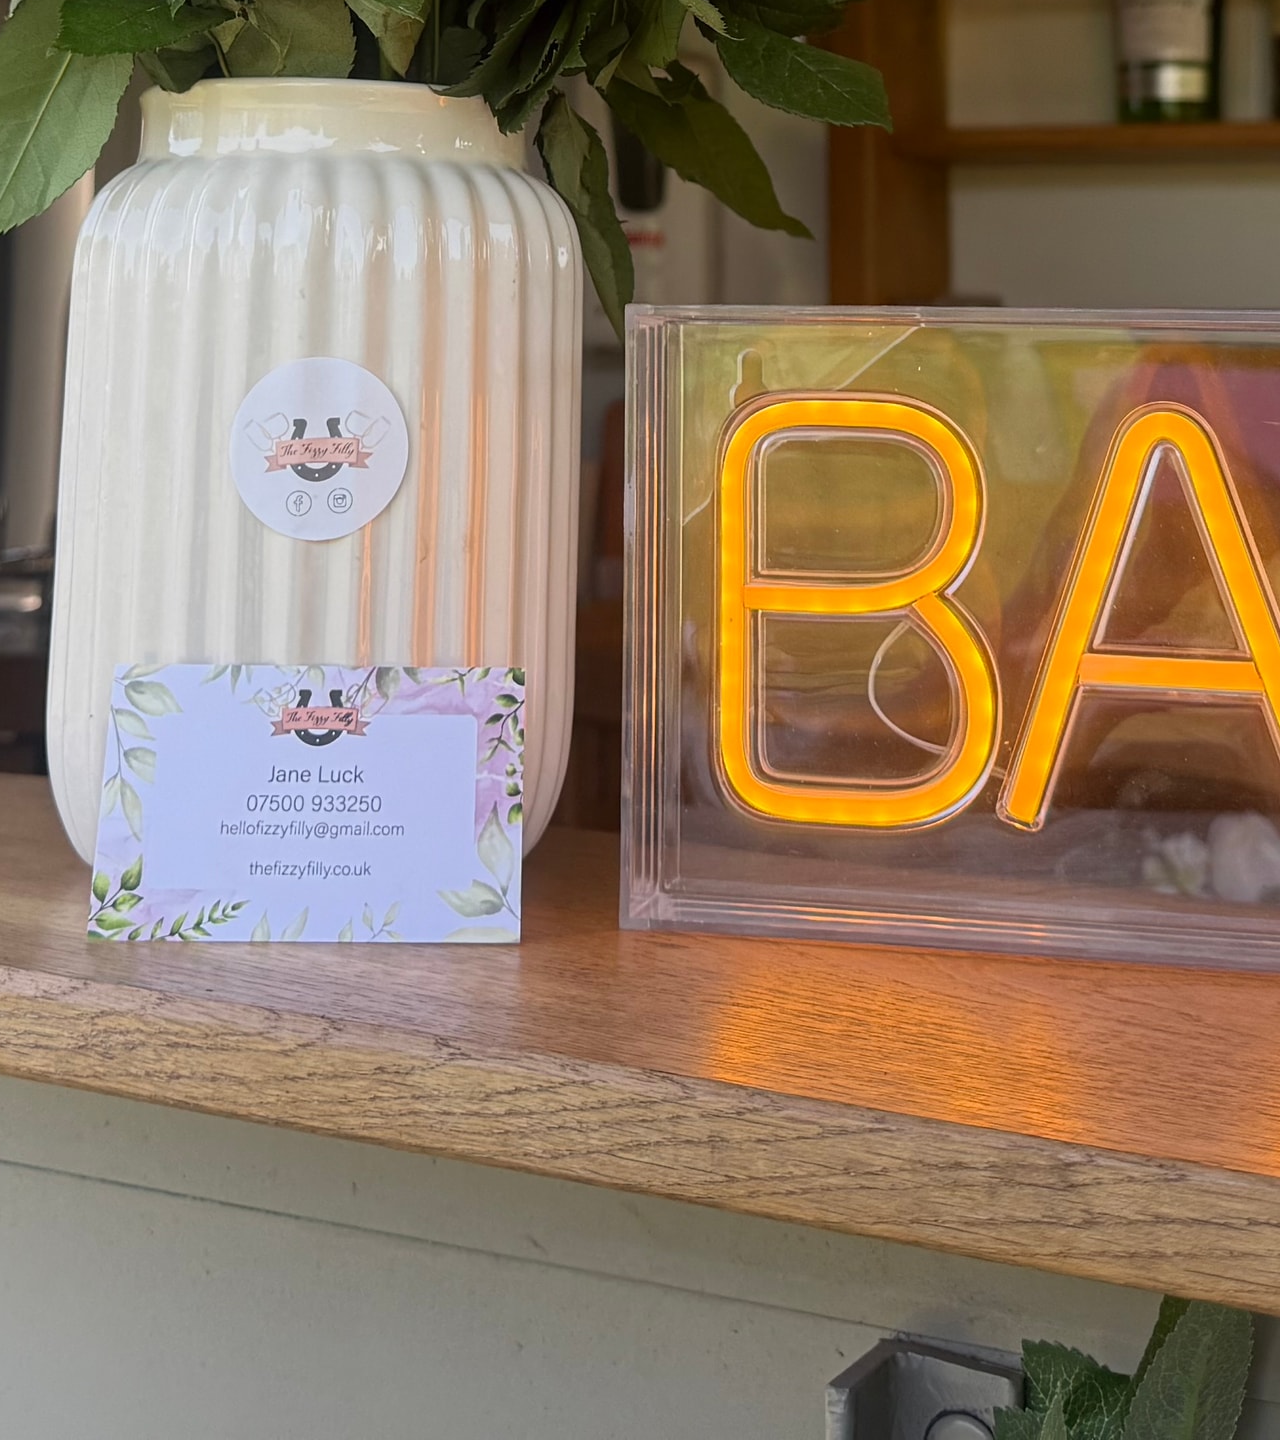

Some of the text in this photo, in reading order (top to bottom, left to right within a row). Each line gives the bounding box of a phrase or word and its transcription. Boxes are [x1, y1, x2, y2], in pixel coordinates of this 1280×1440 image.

[280, 441, 355, 460] The Fizzy Filly
[285, 710, 354, 727] The Fizzy Filly
[267, 764, 365, 784] Jane Luck
[246, 793, 382, 813] 07500 933250
[220, 819, 405, 840] hellofizzyfilly@gmail.com
[249, 860, 372, 880] thefizzyfilly.co.uk
